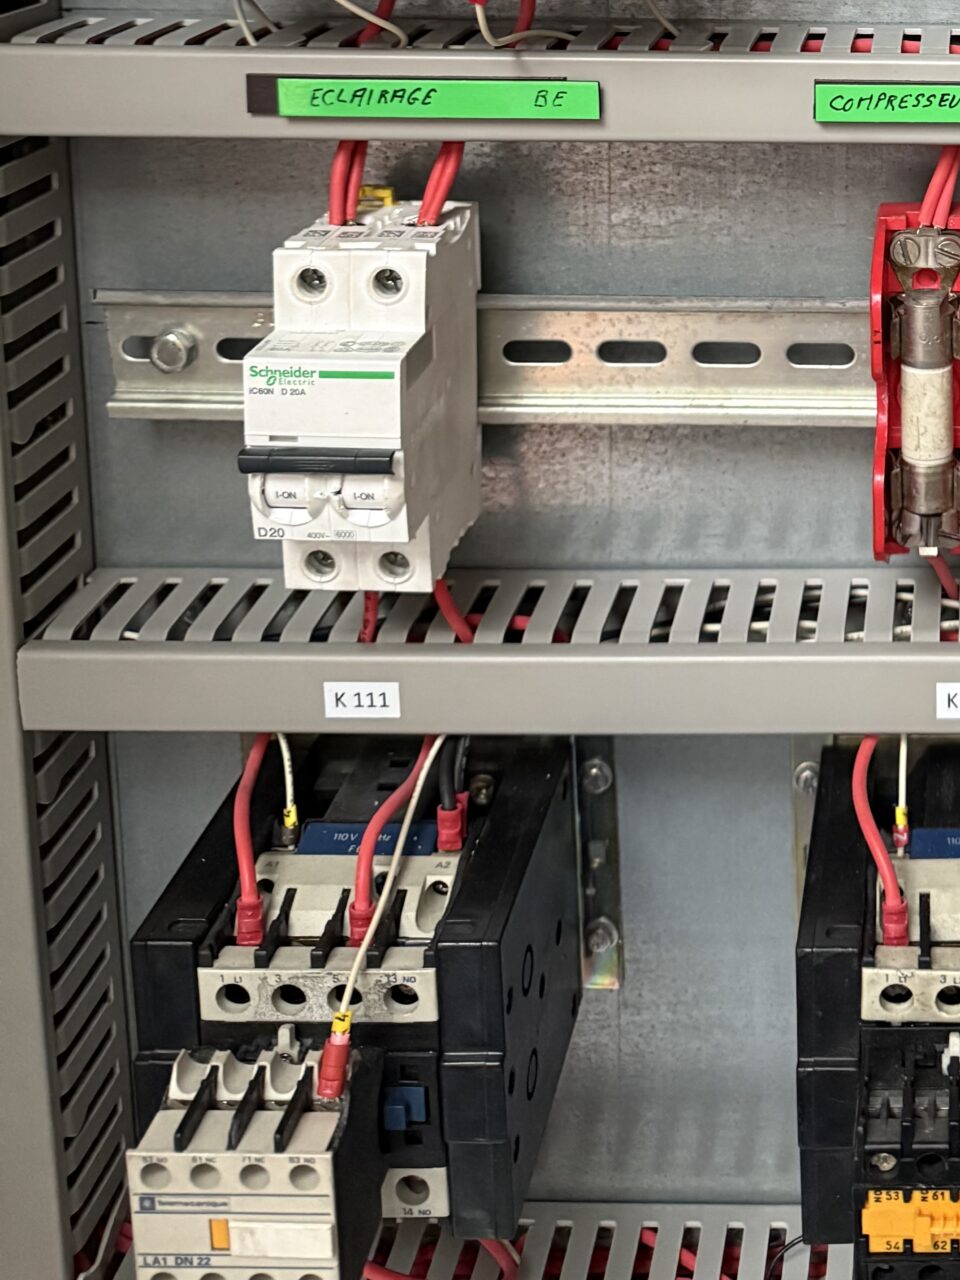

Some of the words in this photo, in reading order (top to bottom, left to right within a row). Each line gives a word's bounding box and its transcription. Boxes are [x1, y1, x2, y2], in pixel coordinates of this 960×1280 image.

[309, 87, 438, 107] ECLAIRAGE
[534, 89, 567, 108] BE
[249, 365, 317, 378] Schneider
[278, 378, 316, 386] Electric
[257, 527, 285, 538] D20
[334, 691, 347, 708] K
[353, 691, 390, 708] 111
[947, 692, 959, 709] K
[939, 975, 947, 984] 3
[886, 1190, 900, 1201] 53
[932, 1191, 945, 1201] 61
[886, 1240, 900, 1250] 54
[933, 1240, 947, 1250] 62
[143, 1257, 168, 1266] LA1
[175, 1257, 194, 1266] DN
[197, 1257, 211, 1266] 22
